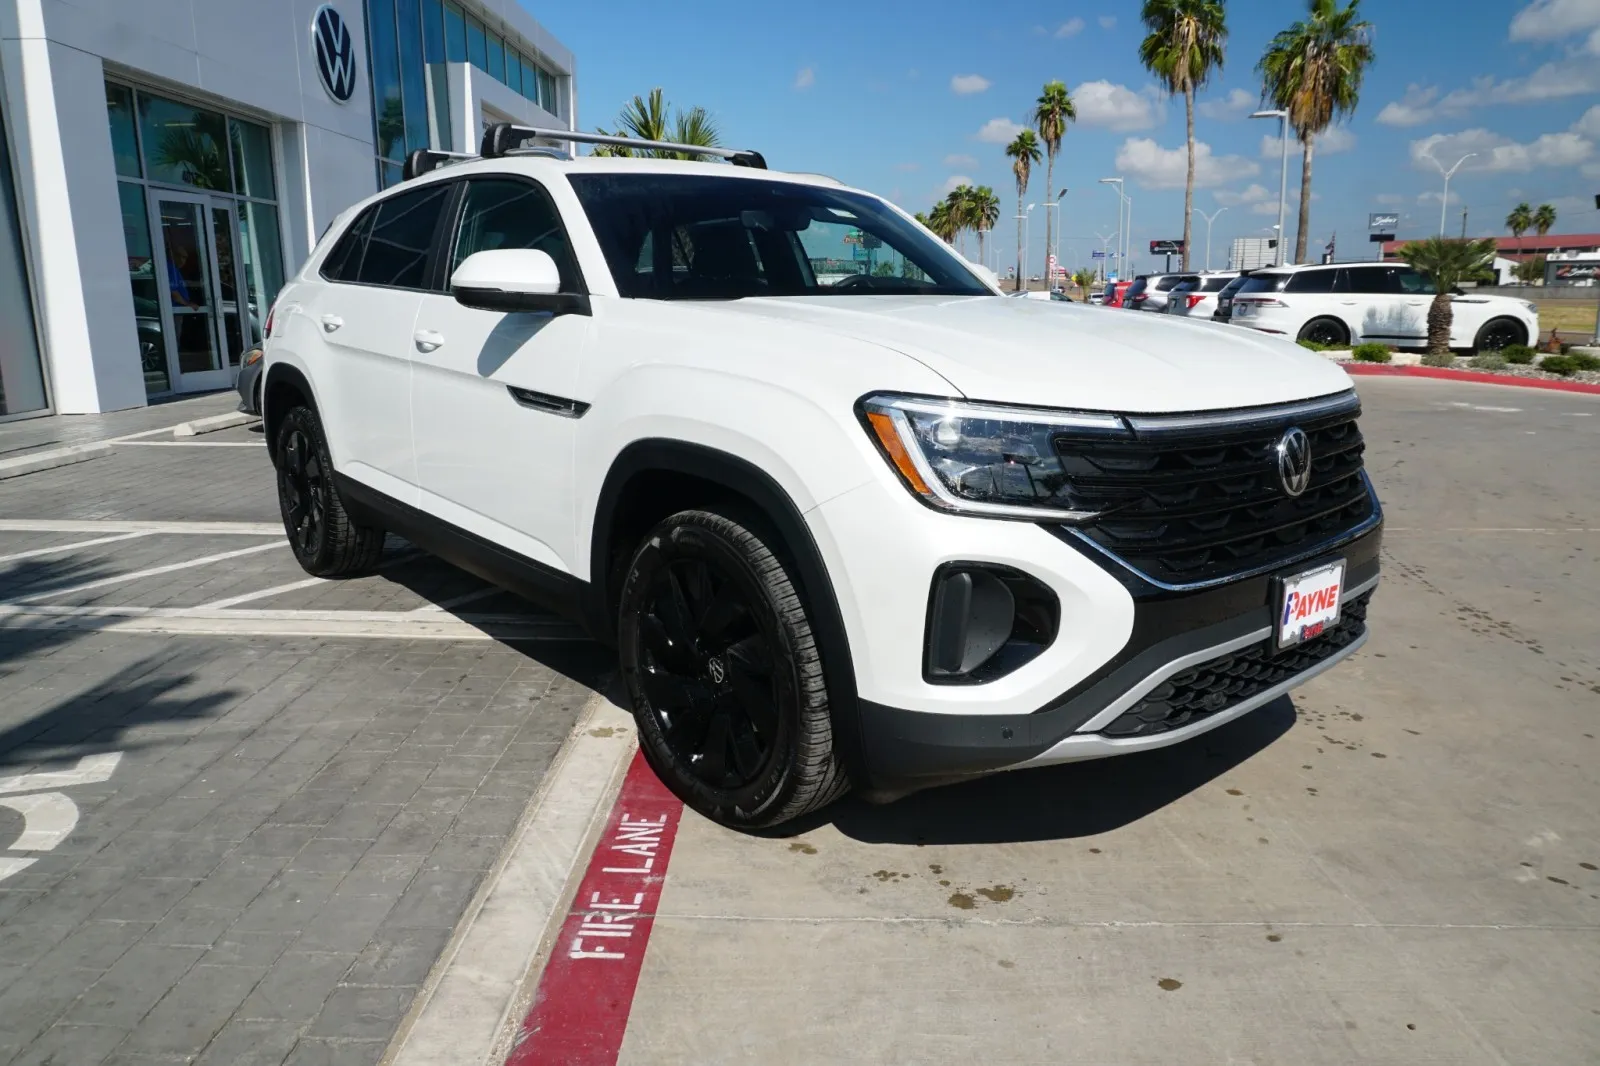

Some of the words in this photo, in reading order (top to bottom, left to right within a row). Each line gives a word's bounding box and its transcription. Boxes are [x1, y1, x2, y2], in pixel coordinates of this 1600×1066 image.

[312, 4, 357, 104] VW
[1283, 584, 1339, 626] PAYNE
[602, 813, 668, 874] LANE
[570, 891, 644, 959] FIRE
